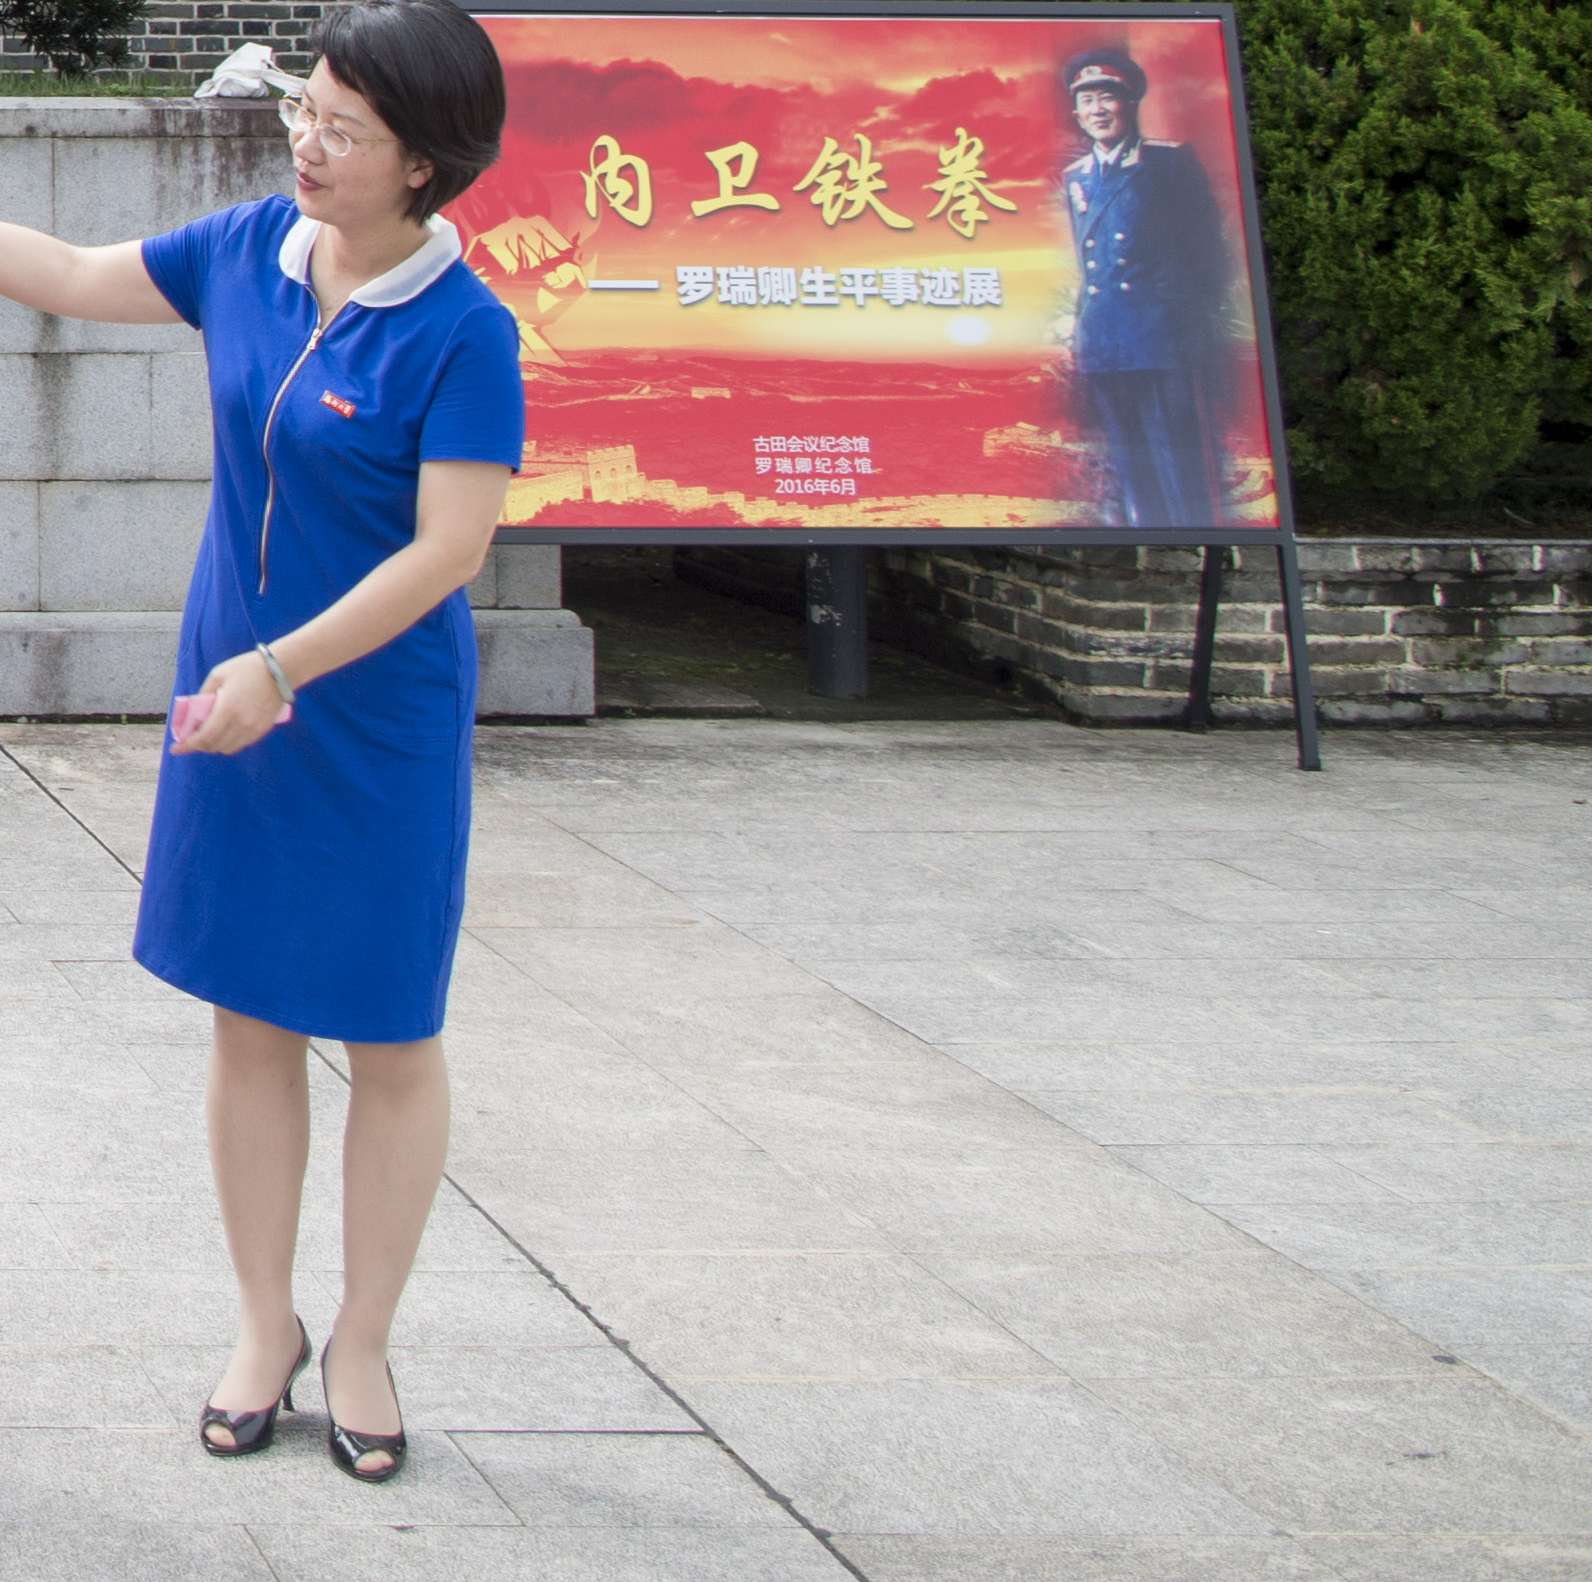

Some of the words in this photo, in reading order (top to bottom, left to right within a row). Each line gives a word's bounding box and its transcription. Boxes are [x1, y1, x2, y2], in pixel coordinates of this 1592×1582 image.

[579, 127, 1018, 238] 内卫铁拳
[676, 265, 1004, 308] 罗瑞卿生平事迹展
[753, 435, 871, 453] 古田会议纪念馆
[755, 457, 873, 474] 罗瑞卿纪念馆
[775, 478, 856, 495] 2016年6月
